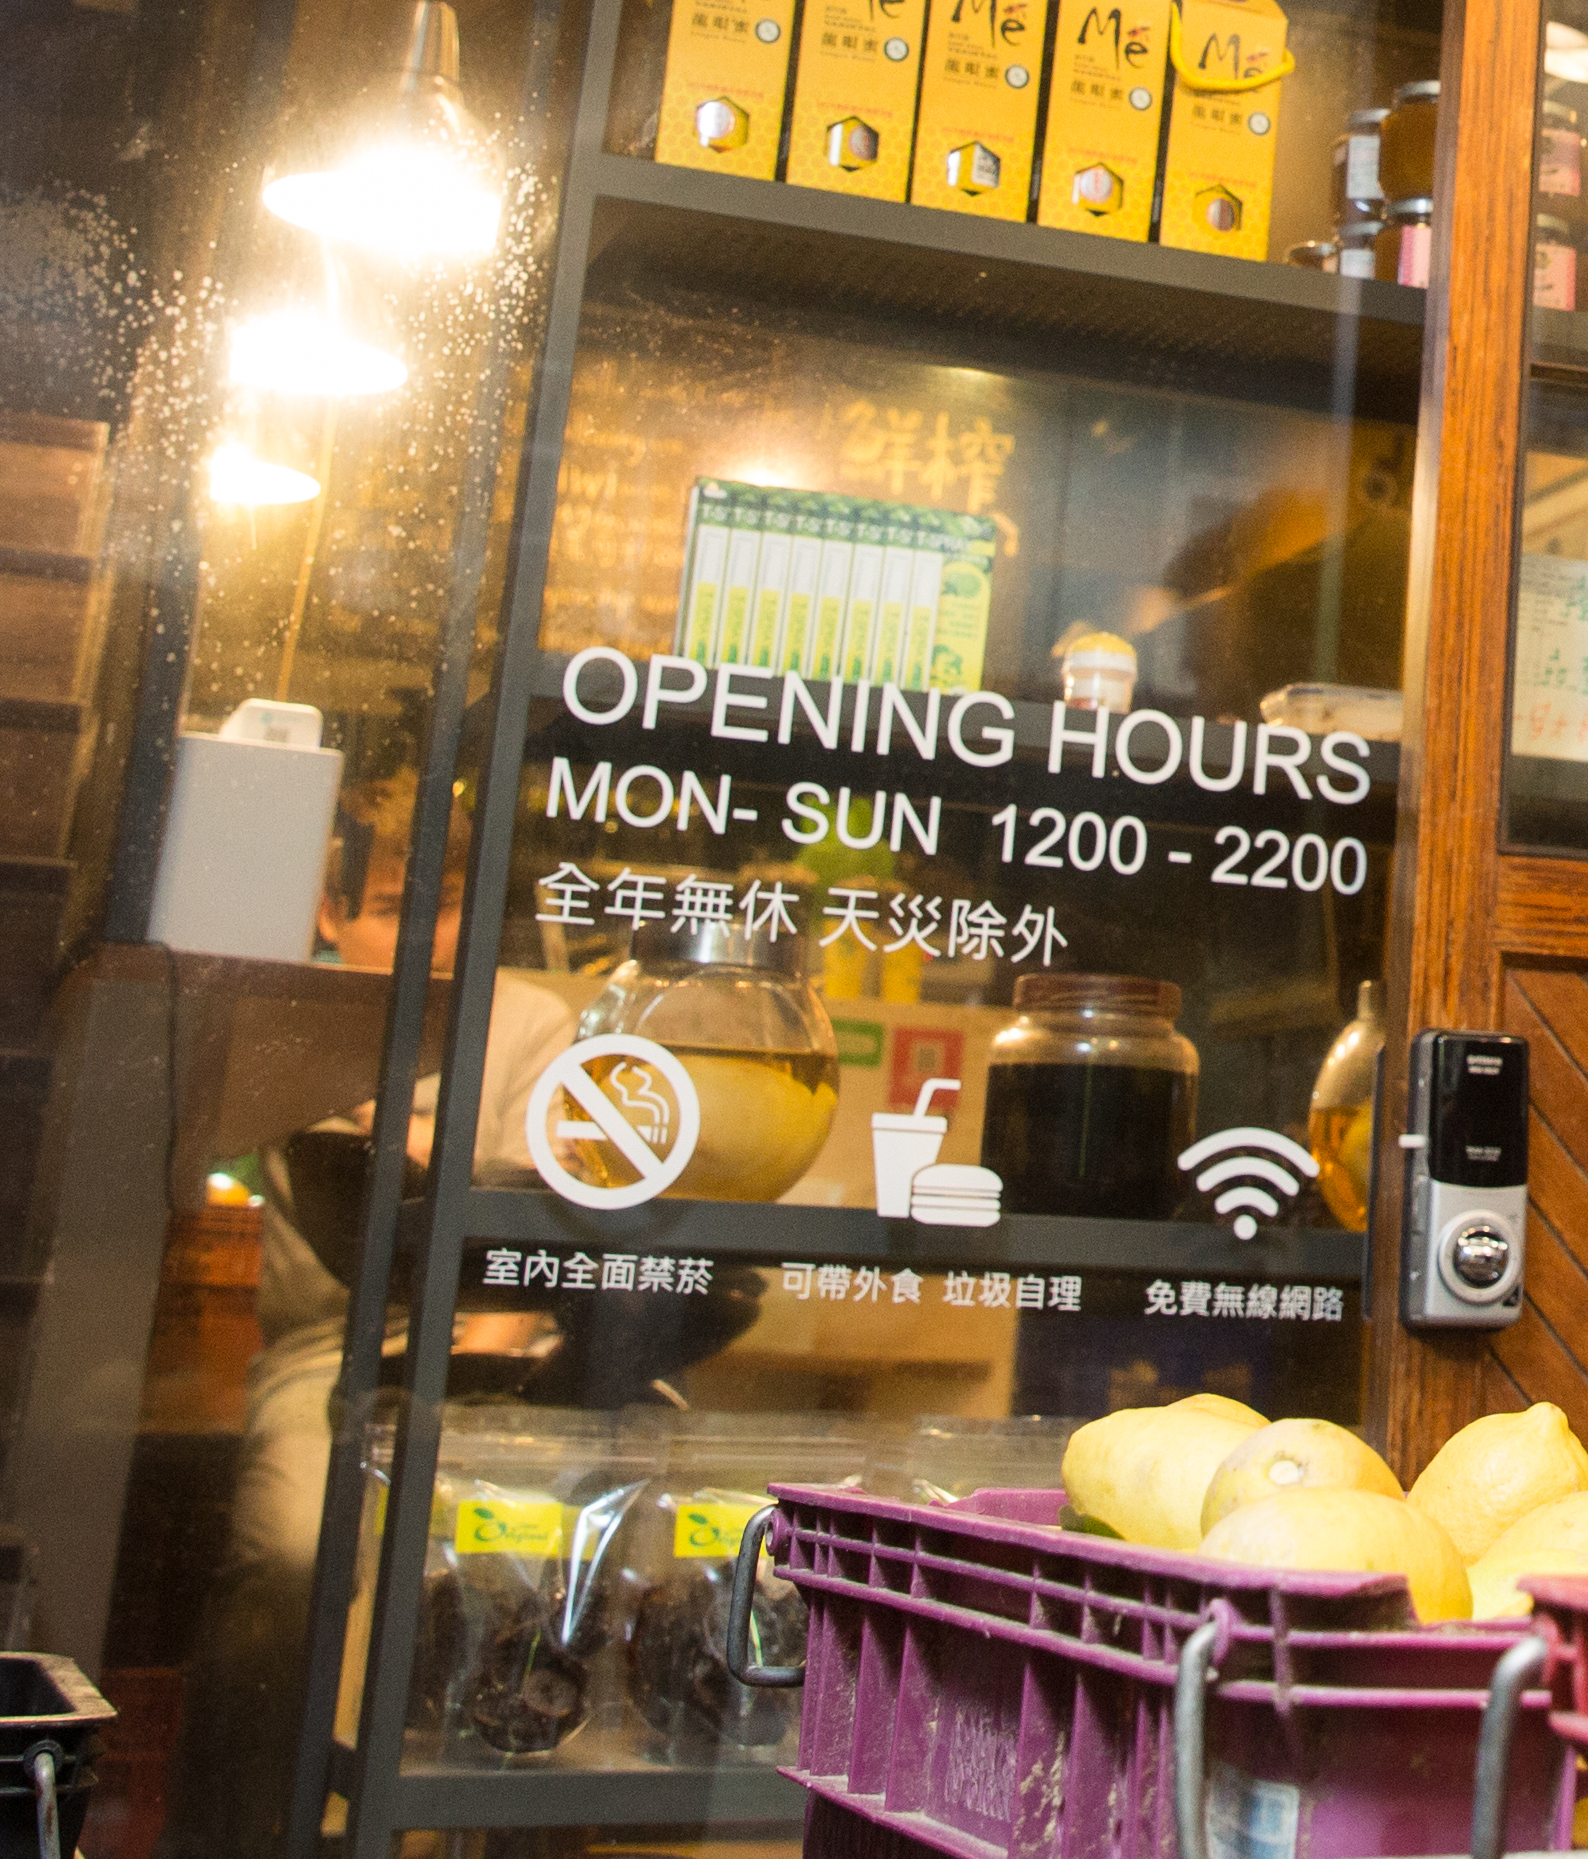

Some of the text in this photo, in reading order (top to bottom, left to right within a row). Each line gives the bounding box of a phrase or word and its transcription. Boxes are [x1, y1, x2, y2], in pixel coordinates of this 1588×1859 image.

[562, 646, 1373, 806] OPENING HOURS
[780, 781, 942, 857] SUN
[991, 804, 1147, 876] 1200
[1211, 825, 1368, 897] 2200
[535, 861, 1068, 968] 全年無休 天災除外
[482, 1247, 715, 1296] 室內全面禁菸
[781, 1261, 1083, 1312] 可帶外食 垃圾自理
[1144, 1278, 1345, 1322] 免費無線網路
